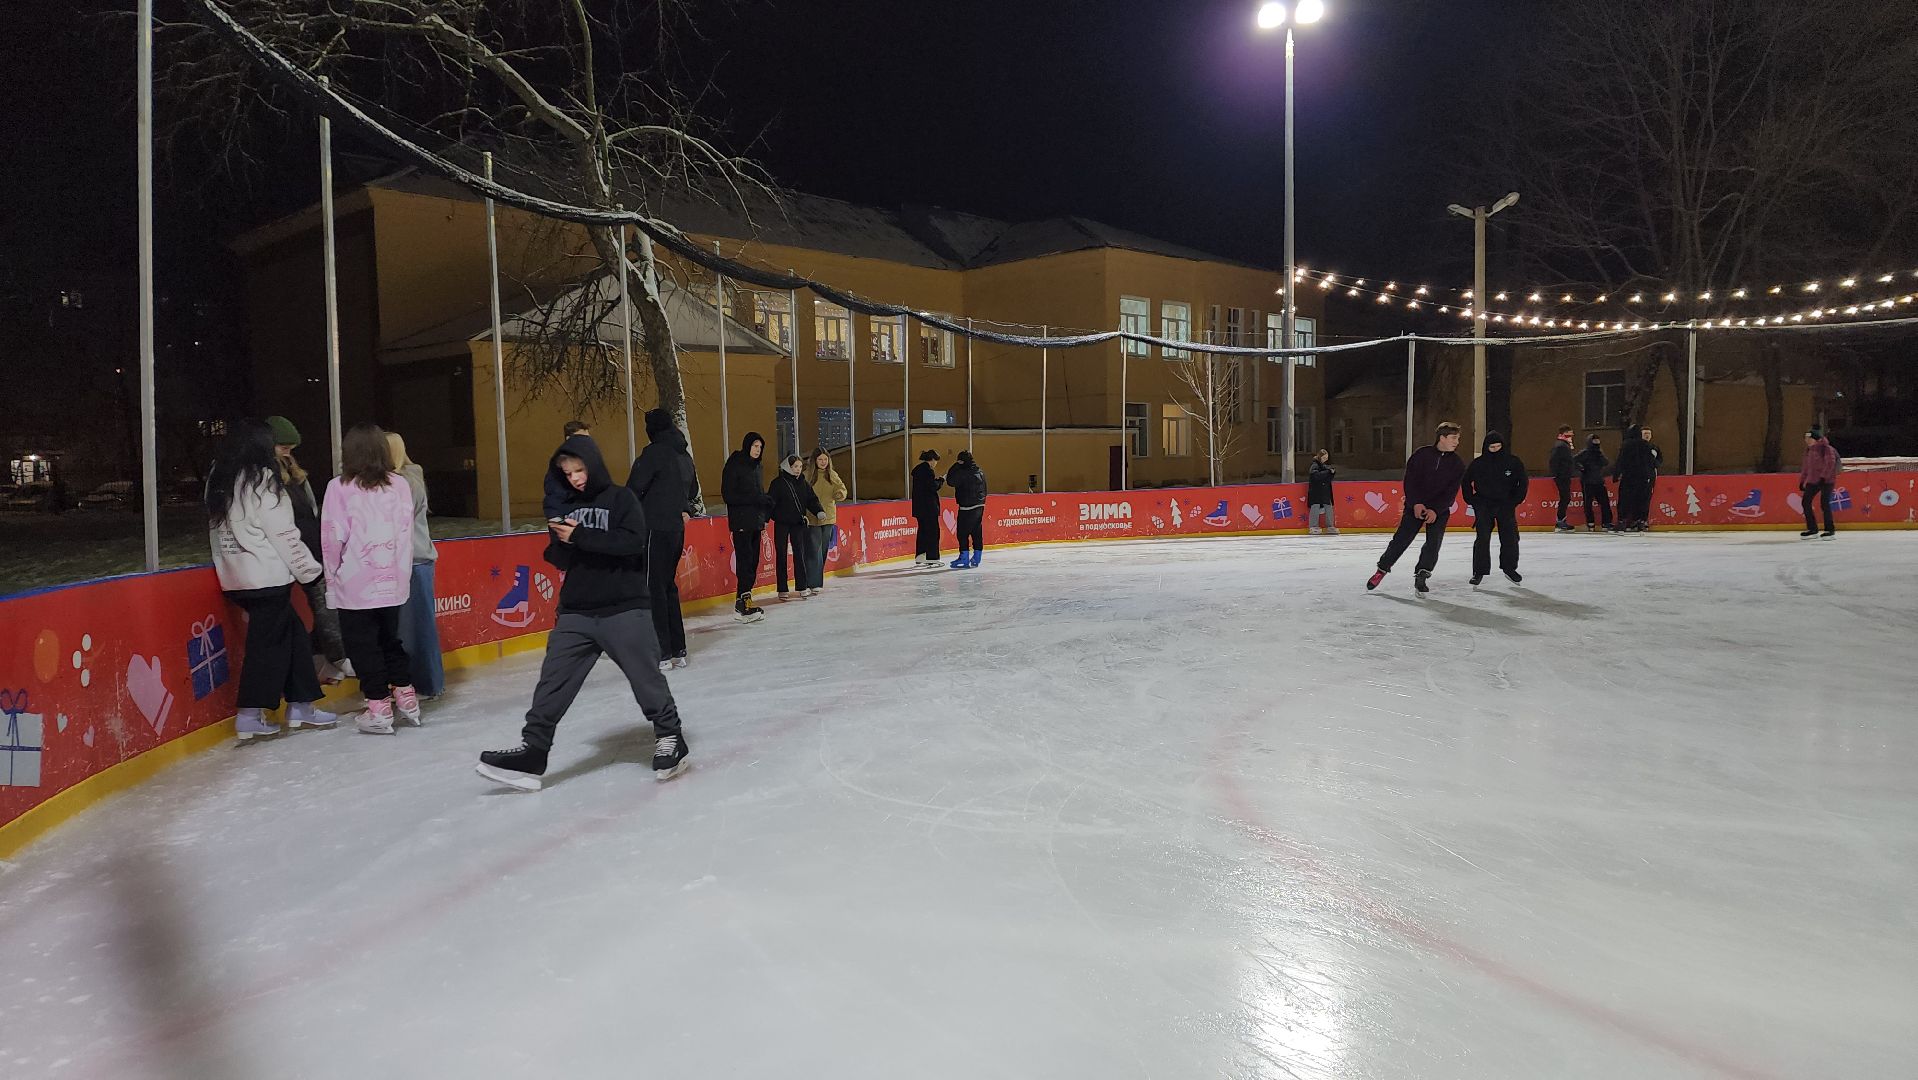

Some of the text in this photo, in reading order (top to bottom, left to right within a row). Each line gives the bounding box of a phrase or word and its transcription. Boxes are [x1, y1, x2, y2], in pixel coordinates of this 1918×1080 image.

[1008, 506, 1044, 516] КАТАЙТЕСЬ
[1079, 501, 1132, 521] ЗИМА
[434, 593, 471, 613] КИНО
